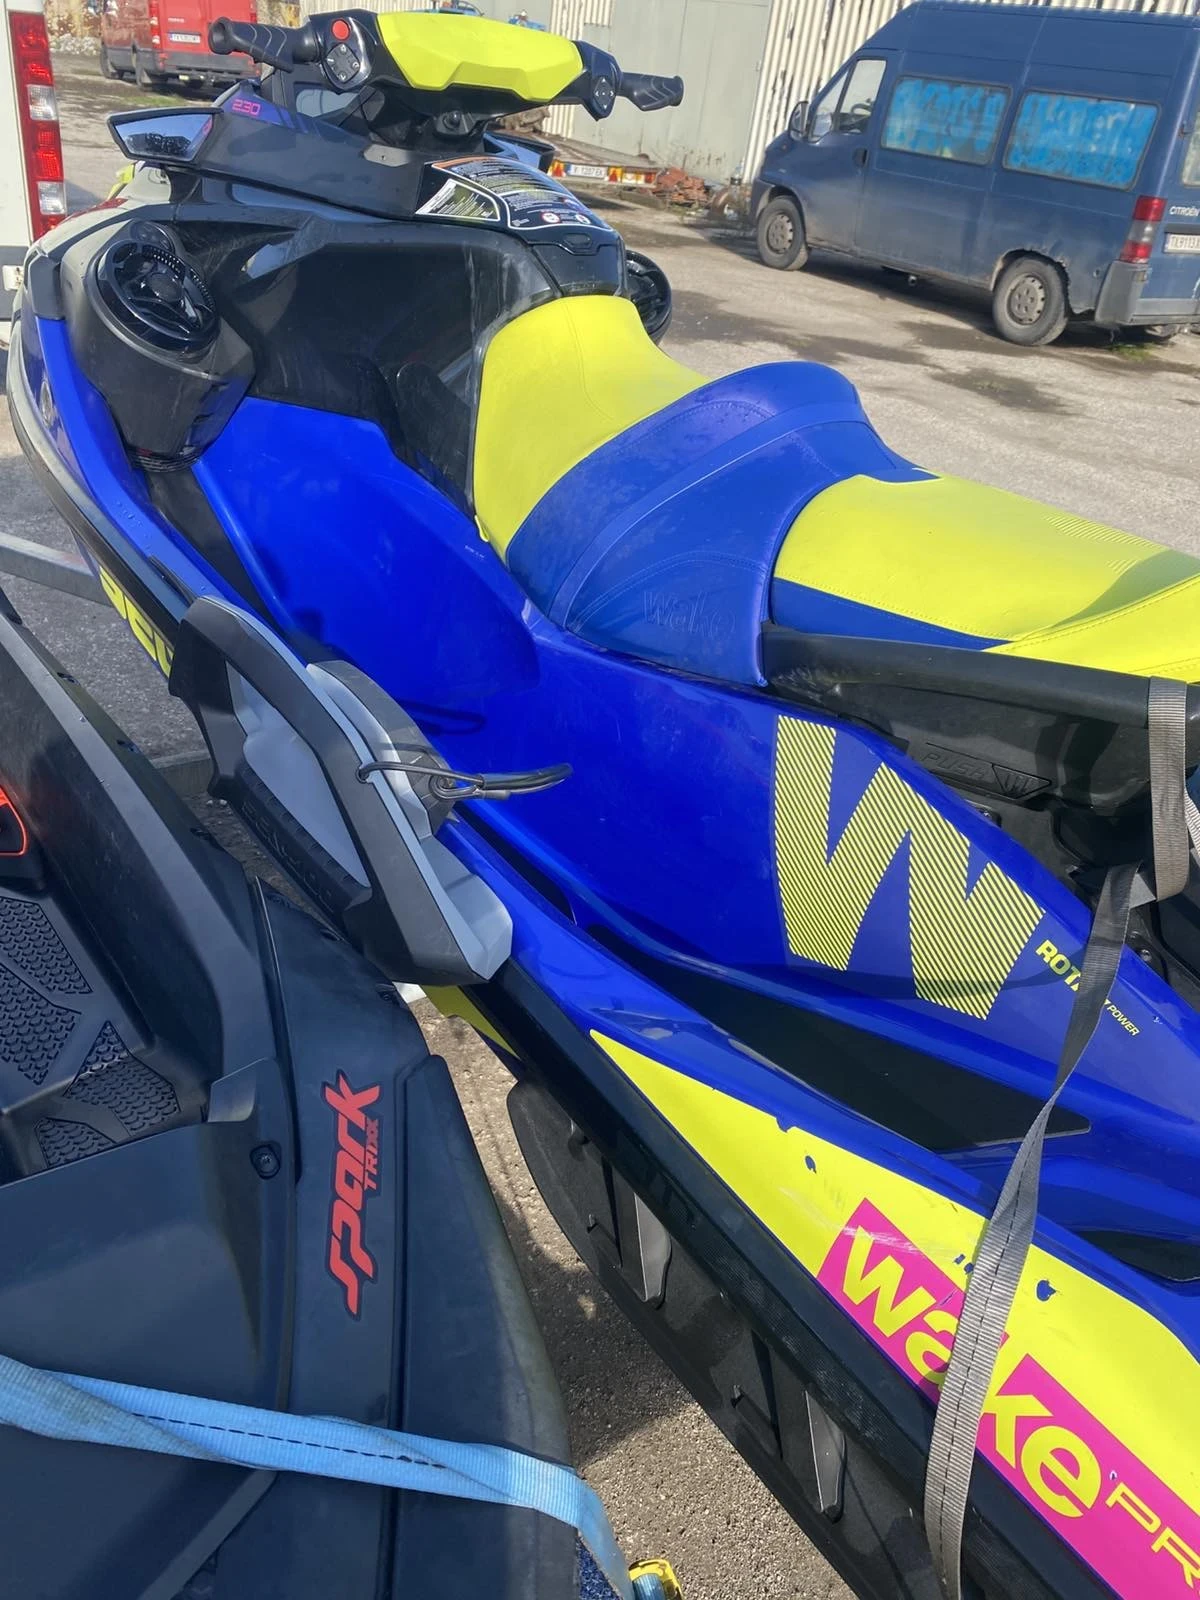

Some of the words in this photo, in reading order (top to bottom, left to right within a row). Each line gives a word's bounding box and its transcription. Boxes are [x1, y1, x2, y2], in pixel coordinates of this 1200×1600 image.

[231, 99, 261, 116] 230
[922, 752, 987, 782] PUSH
[1107, 1005, 1140, 1036] POWER
